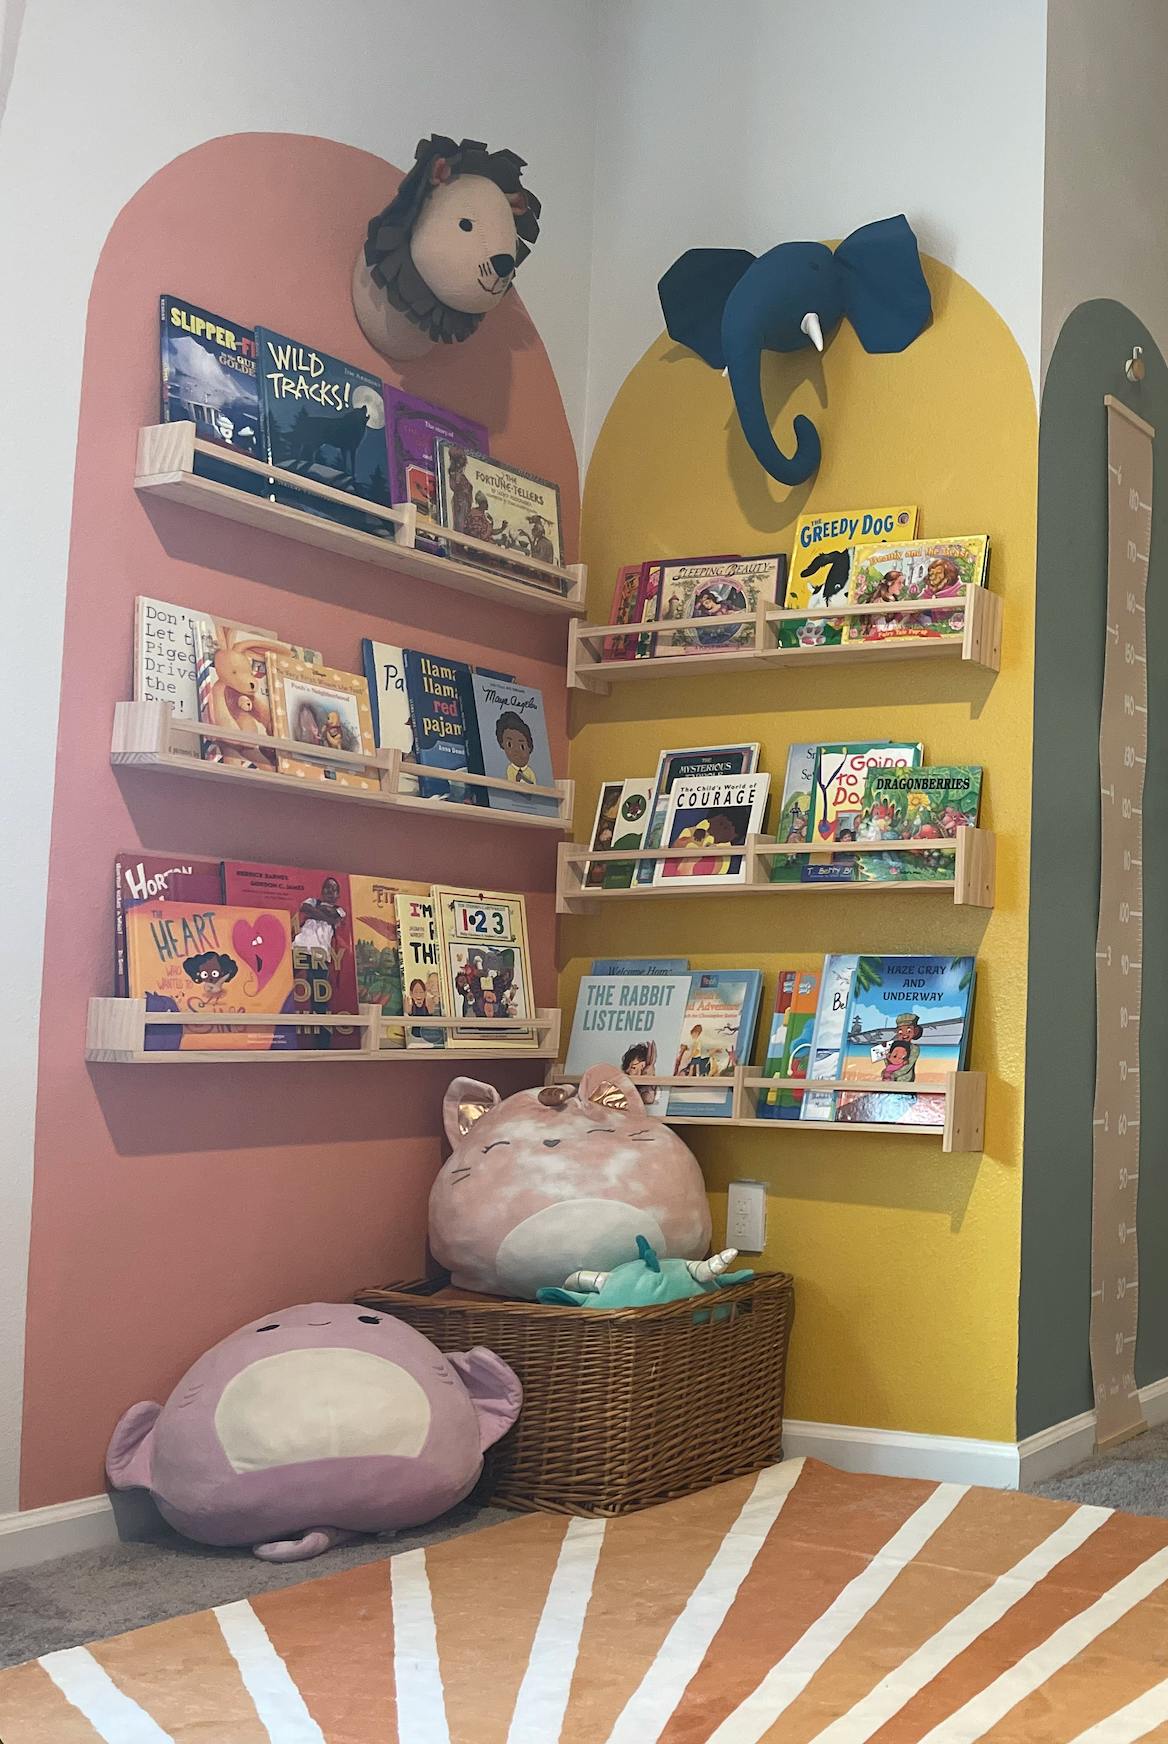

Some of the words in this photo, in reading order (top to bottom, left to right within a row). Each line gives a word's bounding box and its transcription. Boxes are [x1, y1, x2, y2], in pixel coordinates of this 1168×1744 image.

[266, 342, 325, 378] WILD
[266, 372, 351, 411] TRACKS!
[475, 470, 545, 506] FORTUNE-TELLERS
[800, 517, 860, 549] GREEDY
[861, 513, 895, 536] DOG
[672, 567, 723, 581] SLEEPING
[726, 562, 772, 577] BEAUTY
[145, 623, 176, 643] Let
[145, 657, 197, 682] Drive
[384, 664, 405, 693] Pa
[145, 675, 177, 694] the
[431, 700, 458, 717] red
[678, 761, 732, 775] MYSTERIOUS
[724, 783, 746, 791] World
[836, 773, 857, 787] to
[876, 777, 971, 791] DRAGONBERRIES
[677, 788, 757, 808] COURAGE
[150, 911, 220, 963] HEART
[886, 964, 916, 975] HAZE
[917, 964, 947, 975] GRAY
[902, 979, 926, 988] AND
[586, 985, 616, 1007] THE
[619, 984, 676, 1007] RABBIT
[883, 992, 944, 1001] UNDERWAY
[582, 1010, 656, 1032] LISTENED
